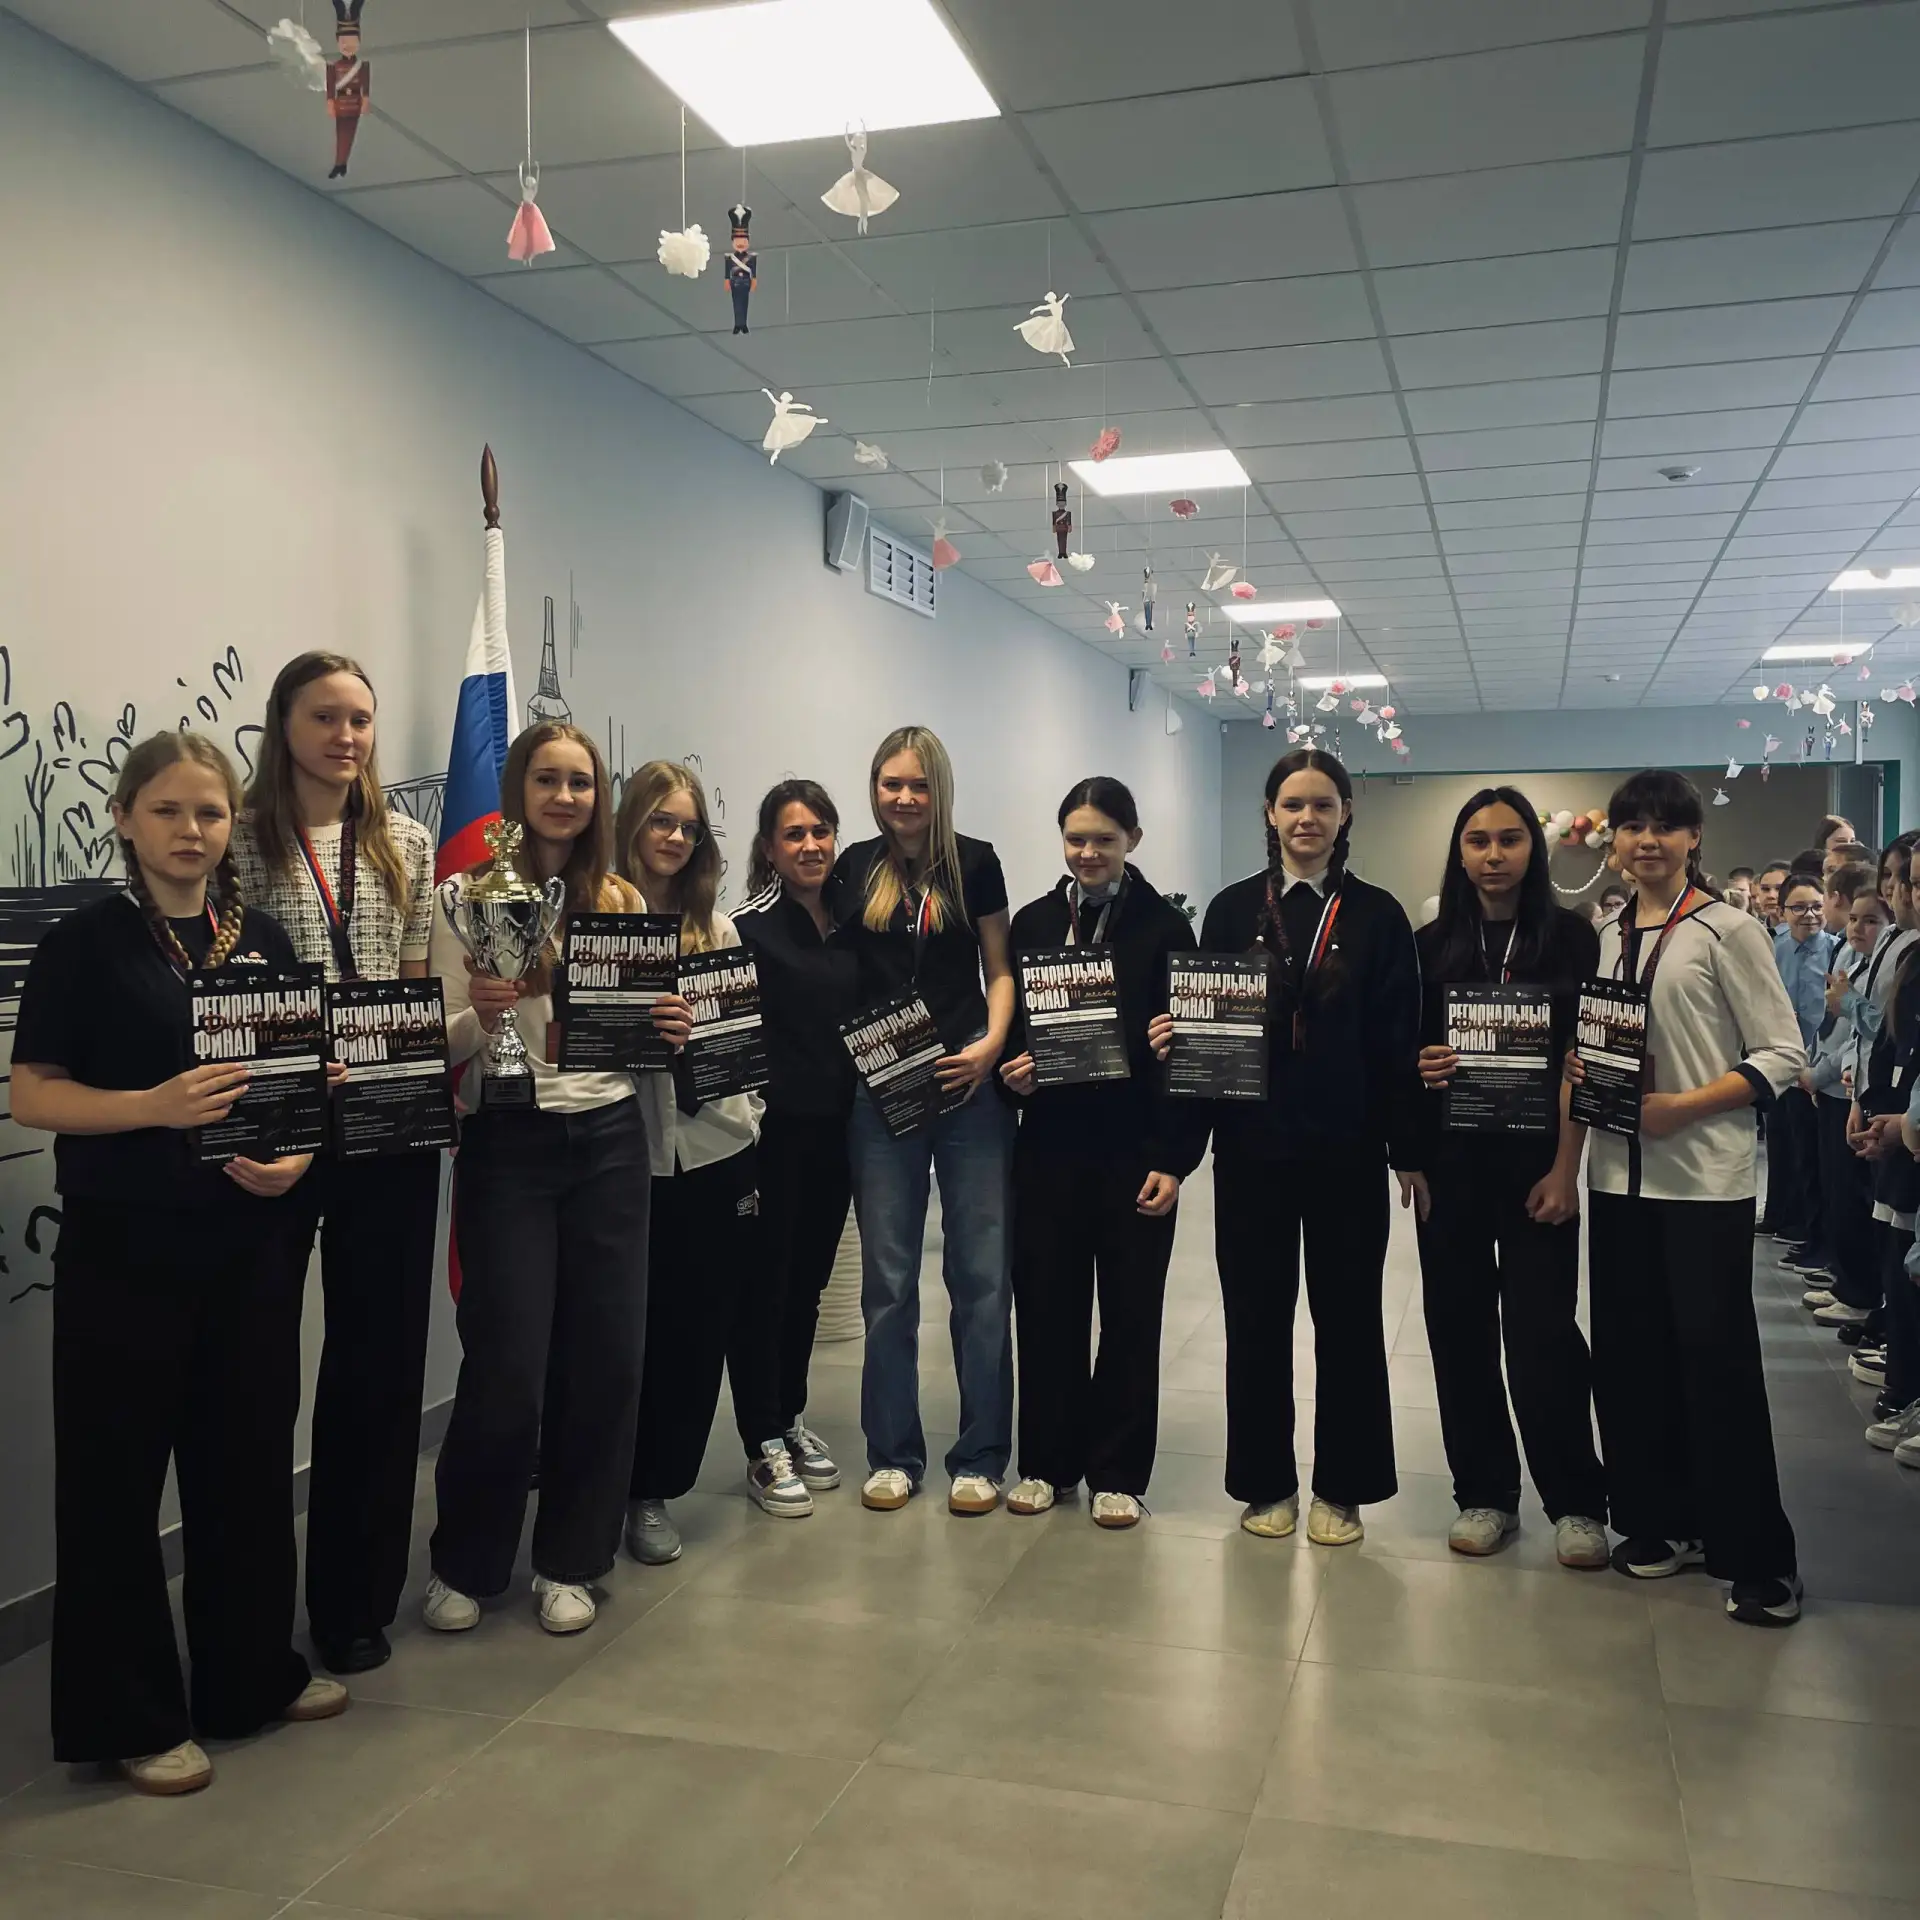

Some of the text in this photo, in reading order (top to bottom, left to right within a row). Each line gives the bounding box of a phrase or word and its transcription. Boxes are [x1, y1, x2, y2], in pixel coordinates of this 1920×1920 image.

[570, 934, 677, 961] РЕГИОНАЛЬНЫЙ
[568, 962, 620, 987] ФИНАЛ
[678, 962, 758, 997] РЕГИОНАЛЬНЫЙ
[1023, 959, 1114, 989] РЕГИОНАЛЬНЫЙ
[1170, 972, 1266, 997] РЕГИОНАЛЬНЫЙ
[192, 985, 322, 1027] РЕГИОНАЛЬНЫЙ
[692, 997, 720, 1023] ИНАЛ
[1025, 988, 1069, 1011] ФИНАЛ
[1170, 996, 1214, 1019] ФИНАЛ
[1579, 995, 1646, 1029] РЕГИОНАЛЬНЫЙ
[332, 997, 442, 1034] РЕГИОНАЛЬНЫЙ
[843, 998, 931, 1055] РЕГИОНАЛЬНЫЙ
[1449, 1003, 1550, 1028] РЕГИОНАЛЬНЫЙ
[194, 1027, 256, 1060] ФИНАЛ
[1448, 1028, 1496, 1051] ФИНАЛ
[1577, 1020, 1606, 1048] ФИНАЛ
[334, 1034, 387, 1065] ФИНАЛ
[854, 1042, 899, 1074] ФИНАЛ
